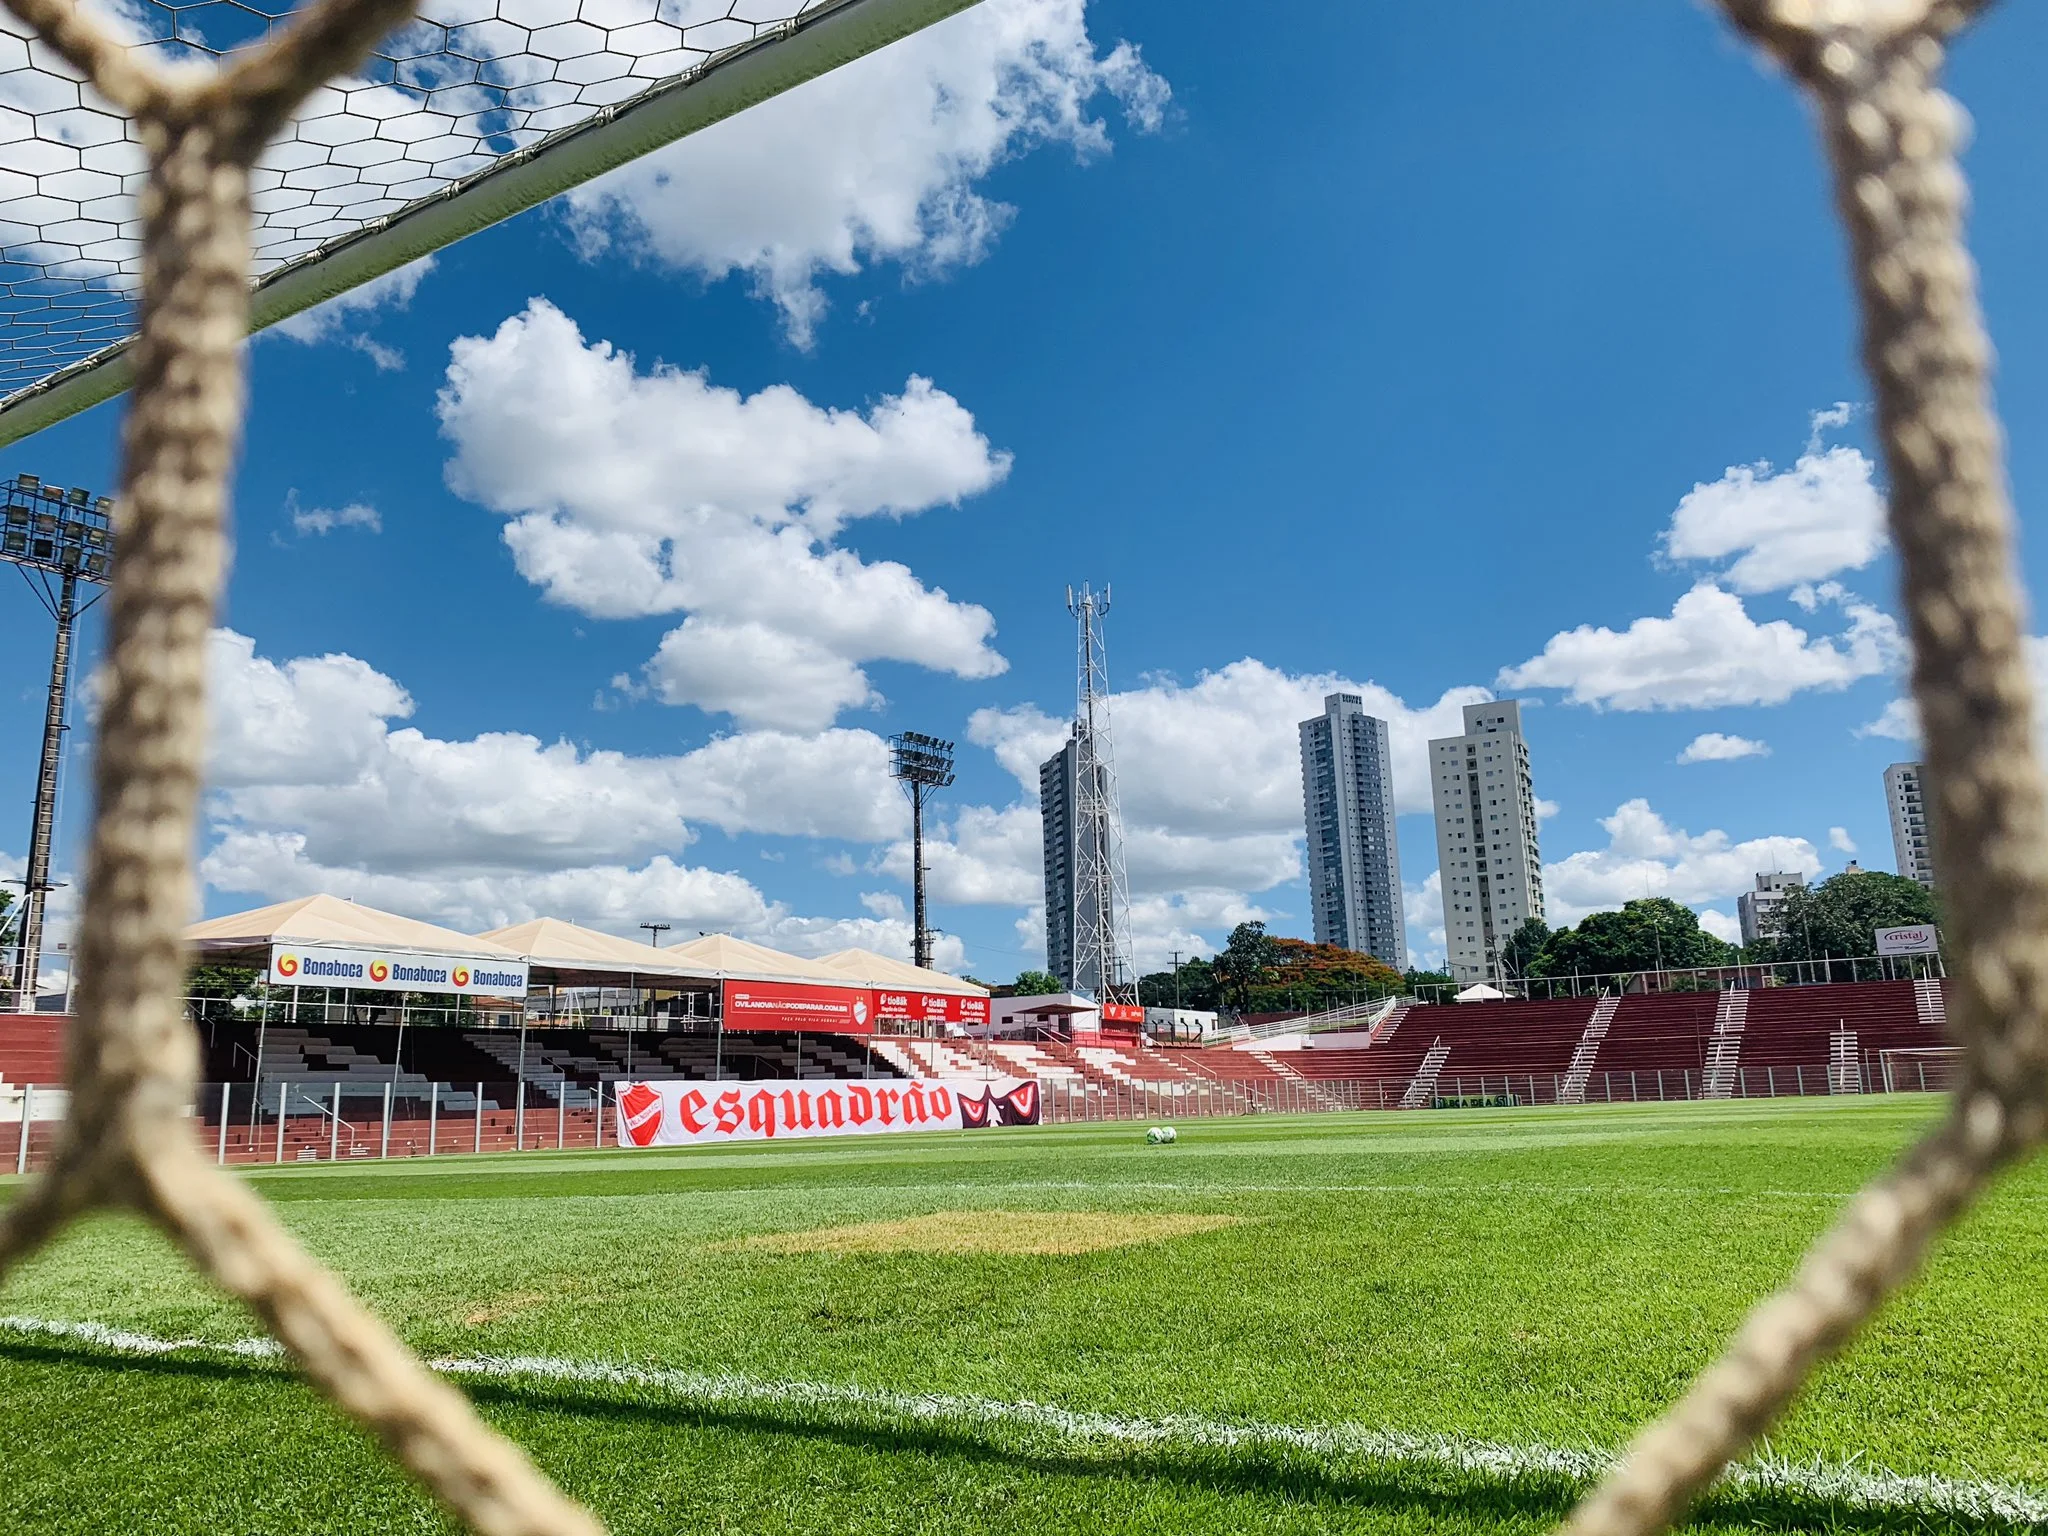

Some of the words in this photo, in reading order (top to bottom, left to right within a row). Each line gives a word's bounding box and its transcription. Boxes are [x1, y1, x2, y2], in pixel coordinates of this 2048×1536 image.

[1889, 930, 1923, 941] cristal
[303, 957, 364, 978] Bonaboca
[393, 963, 447, 983] Bonaboca
[473, 969, 523, 988] Bonaboca
[678, 1081, 953, 1138] esquadrão
